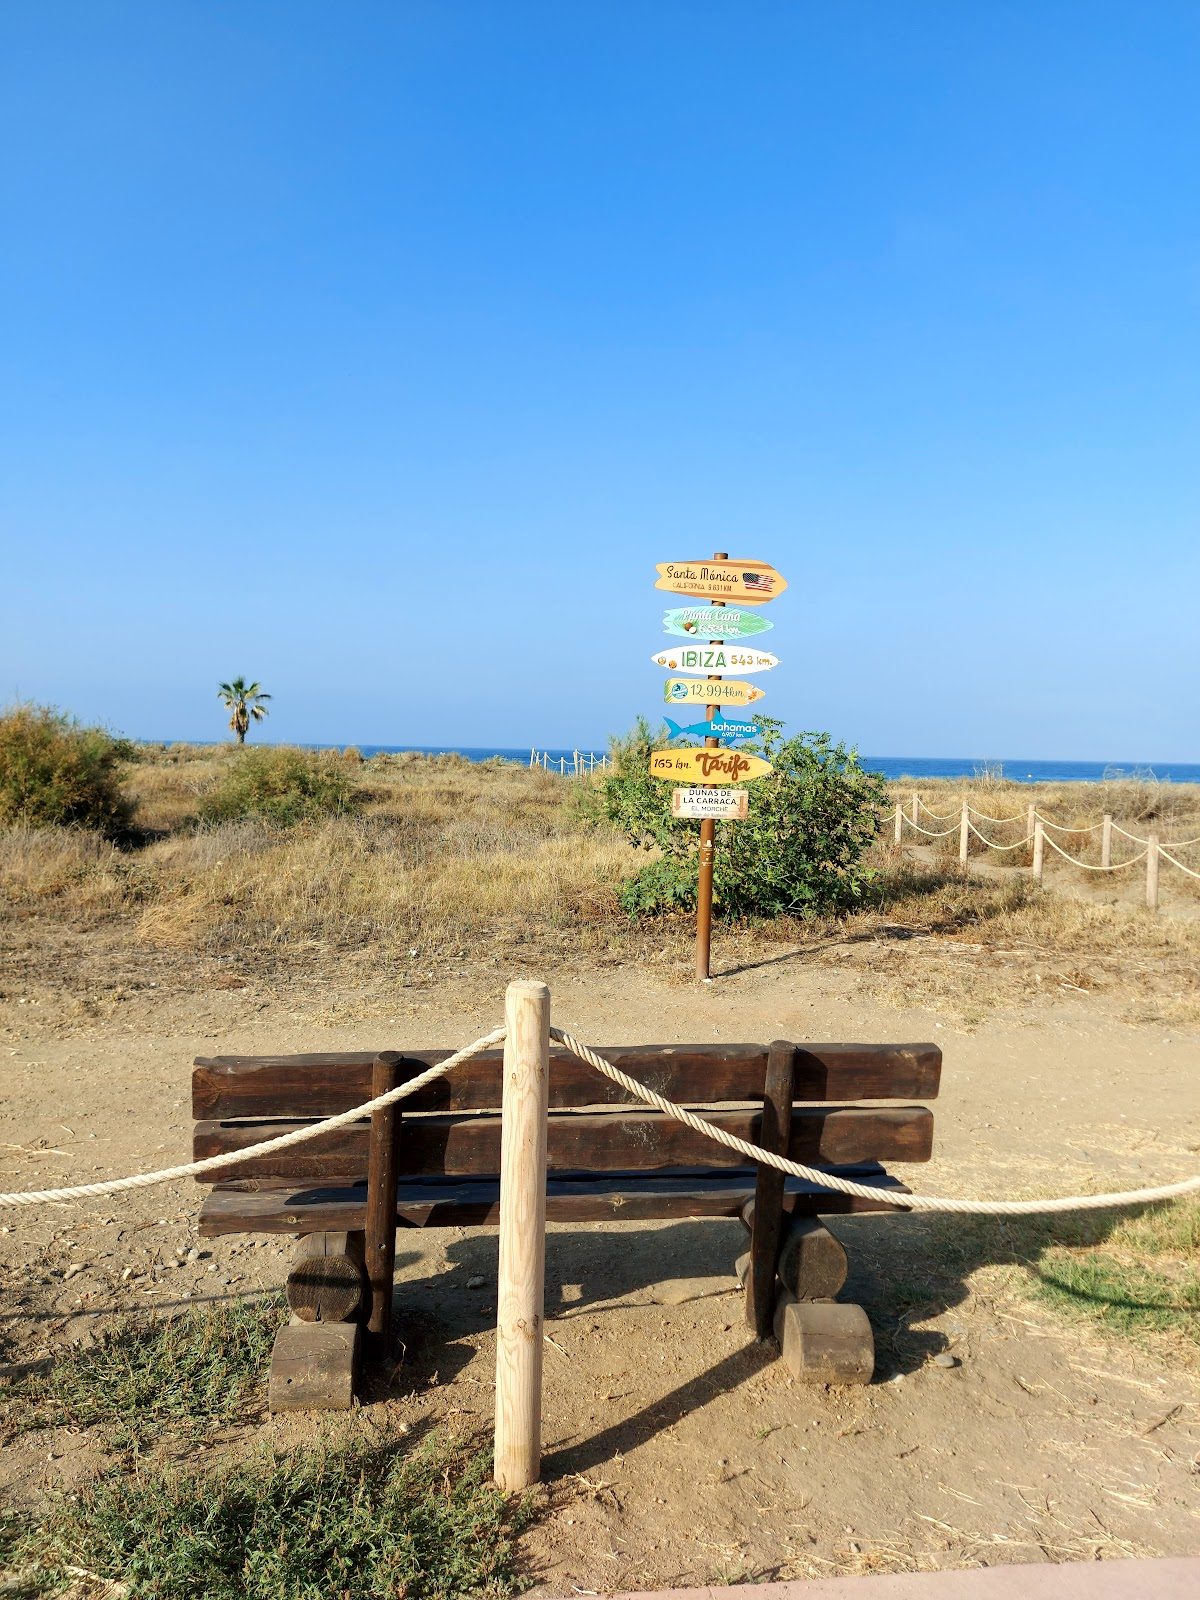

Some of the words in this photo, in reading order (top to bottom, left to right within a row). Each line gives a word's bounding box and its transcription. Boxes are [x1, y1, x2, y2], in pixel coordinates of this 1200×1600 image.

[666, 565, 697, 580] Santa
[700, 567, 739, 583] Mónica
[681, 650, 727, 668] IBIZA
[730, 654, 753, 666] 543
[710, 721, 757, 733] bahamas
[654, 758, 673, 769] 165
[675, 757, 692, 769] km.
[695, 752, 751, 781] Tarifa
[689, 789, 719, 797] DUNAS
[696, 797, 737, 805] CARRACA
